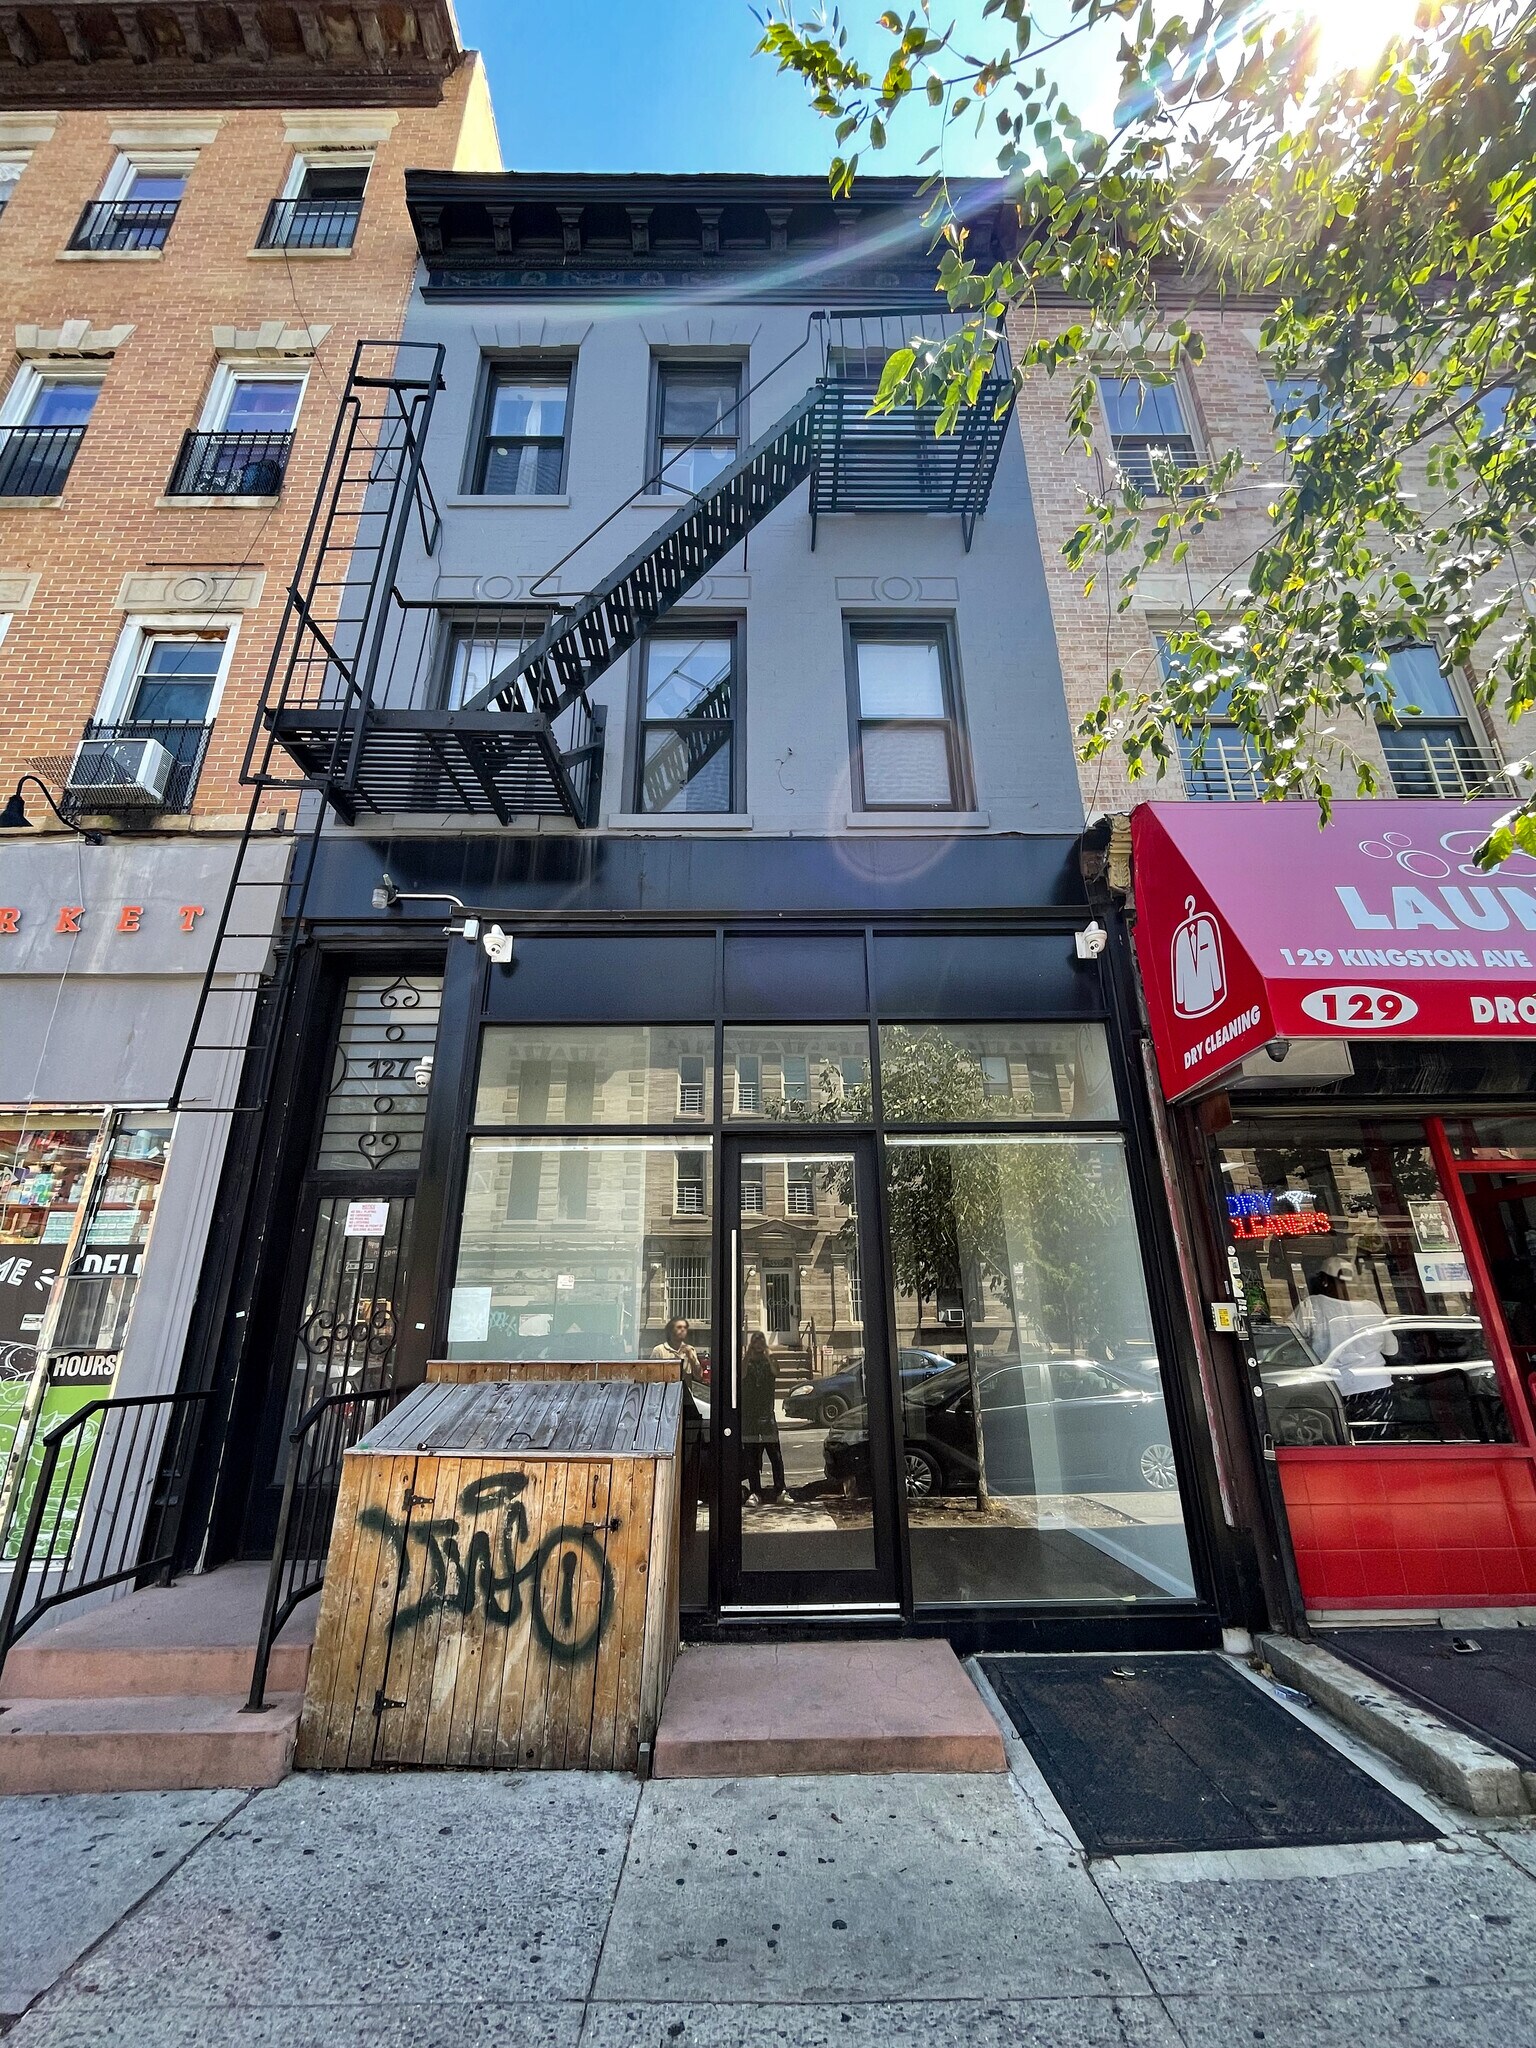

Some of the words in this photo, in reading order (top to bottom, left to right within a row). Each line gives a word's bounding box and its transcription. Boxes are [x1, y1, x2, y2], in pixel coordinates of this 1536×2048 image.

[0, 906, 205, 932] RKET
[1280, 948, 1334, 966] 129
[1337, 949, 1479, 967] KINGSTON
[1482, 950, 1533, 968] AVE
[1322, 994, 1403, 1021] 129
[1184, 1042, 1203, 1070] DRY
[1205, 1005, 1261, 1055] CLEANING
[368, 1058, 411, 1078] 127
[1226, 1192, 1272, 1216] DRY
[53, 1354, 118, 1377] HOURS
